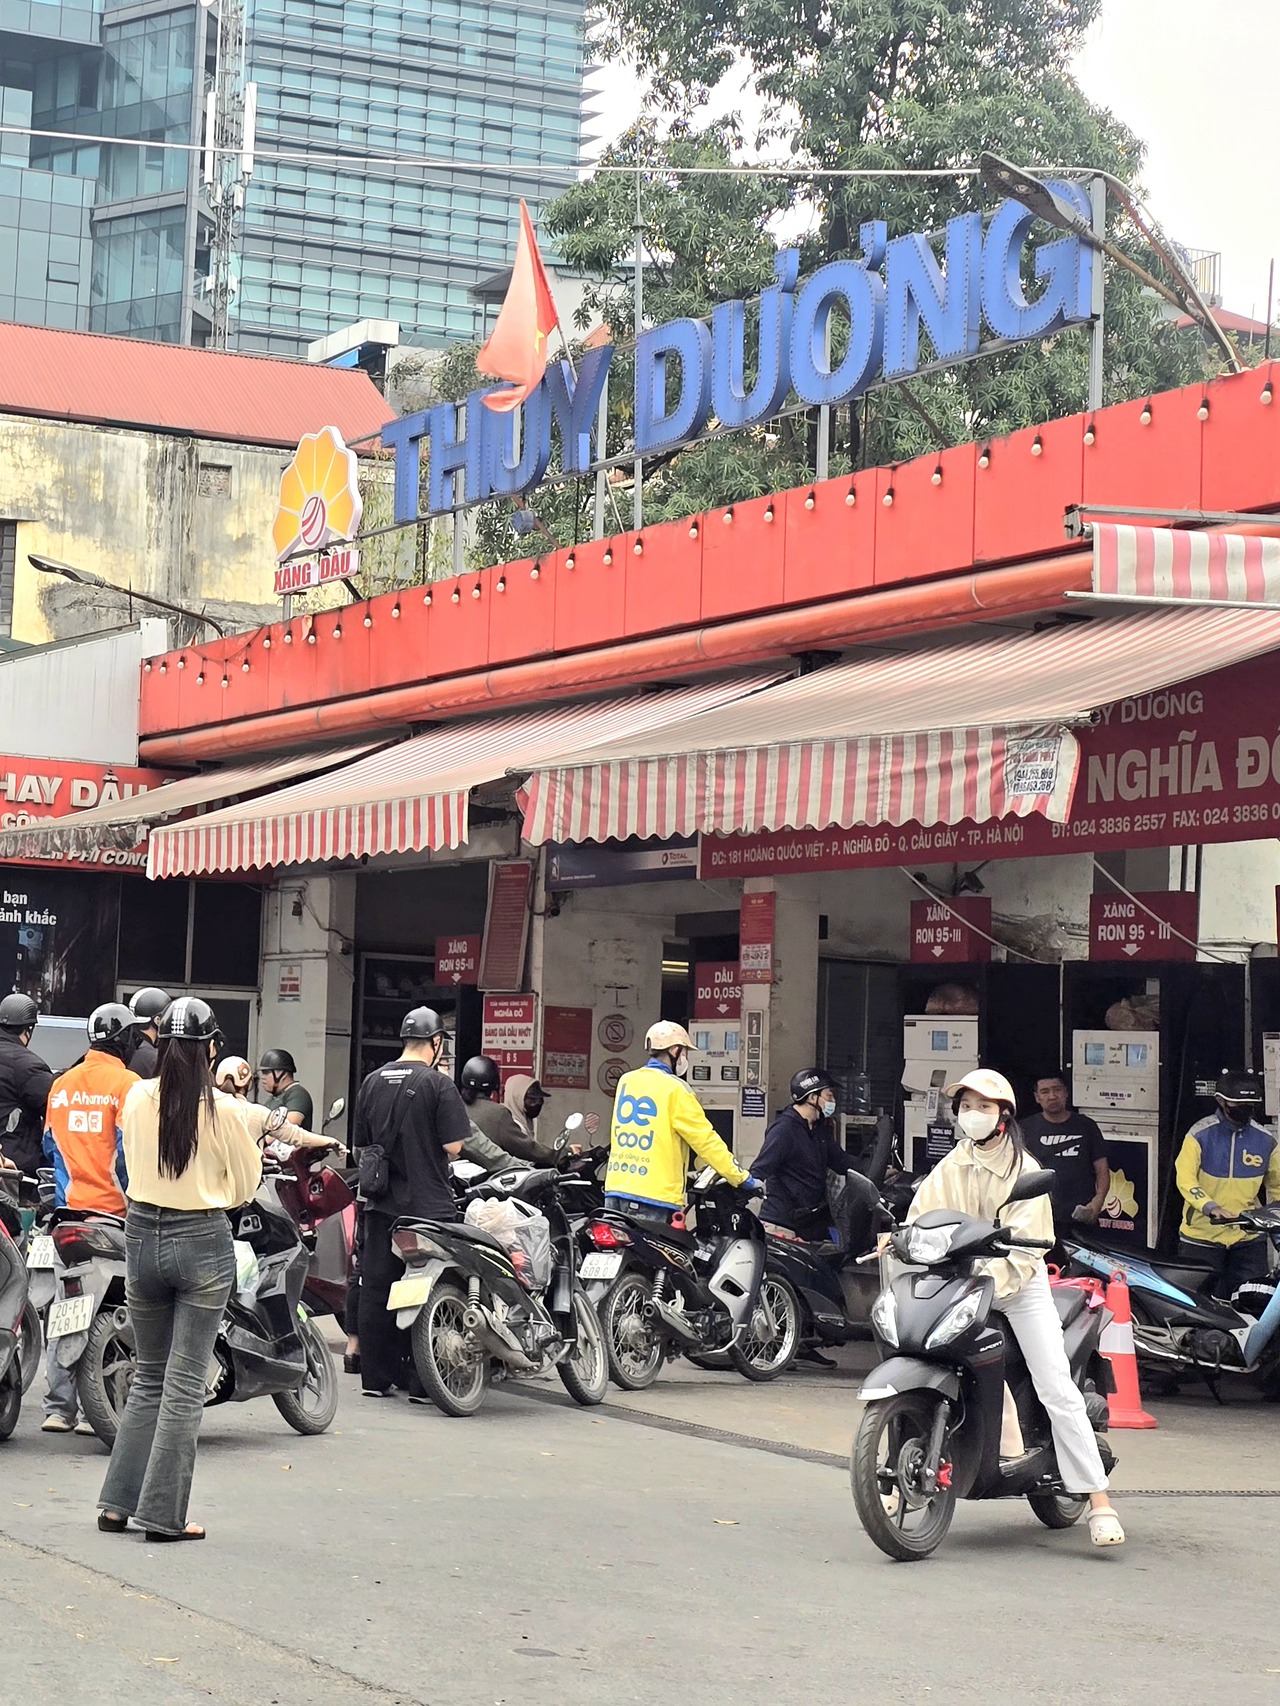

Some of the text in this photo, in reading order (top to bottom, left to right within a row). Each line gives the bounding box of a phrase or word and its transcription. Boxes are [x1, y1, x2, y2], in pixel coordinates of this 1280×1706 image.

[635, 179, 1093, 453] DƯƠNG
[274, 548, 351, 592] XĂNG DẦU
[1122, 690, 1204, 723] DƯƠNG
[1088, 729, 1223, 804] NGHĨA
[1236, 726, 1280, 789] Đ
[1052, 821, 1070, 838] ĐT:
[1073, 819, 1096, 837] 024
[1099, 816, 1131, 834] 3836
[1134, 813, 1166, 832] 2557
[1173, 809, 1200, 828] FAX:
[1203, 807, 1229, 825] 024
[1233, 804, 1268, 822] 3836
[712, 823, 1024, 866] ĐC: 181 HOÀNG QUỐC VIỆT P. NGHĨA ĐÔ Q. CẦU GIẤY TP. HÀ NỘI
[4, 890, 28, 908] bạn
[25, 908, 57, 926] khắc
[926, 903, 950, 921] XĂNG
[1103, 902, 1135, 918] XĂNG
[916, 929, 934, 944] RON
[1098, 925, 1127, 941] RON
[1129, 924, 1145, 940] 95
[448, 939, 467, 954] XĂNG
[439, 959, 454, 971] RON
[714, 966, 733, 983] DẦU
[697, 986, 741, 1000] DO 0,05S
[616, 1083, 657, 1126] be
[1242, 1149, 1263, 1168] be
[55, 1298, 86, 1319] 20-F1
[50, 1313, 86, 1337] 748.11
